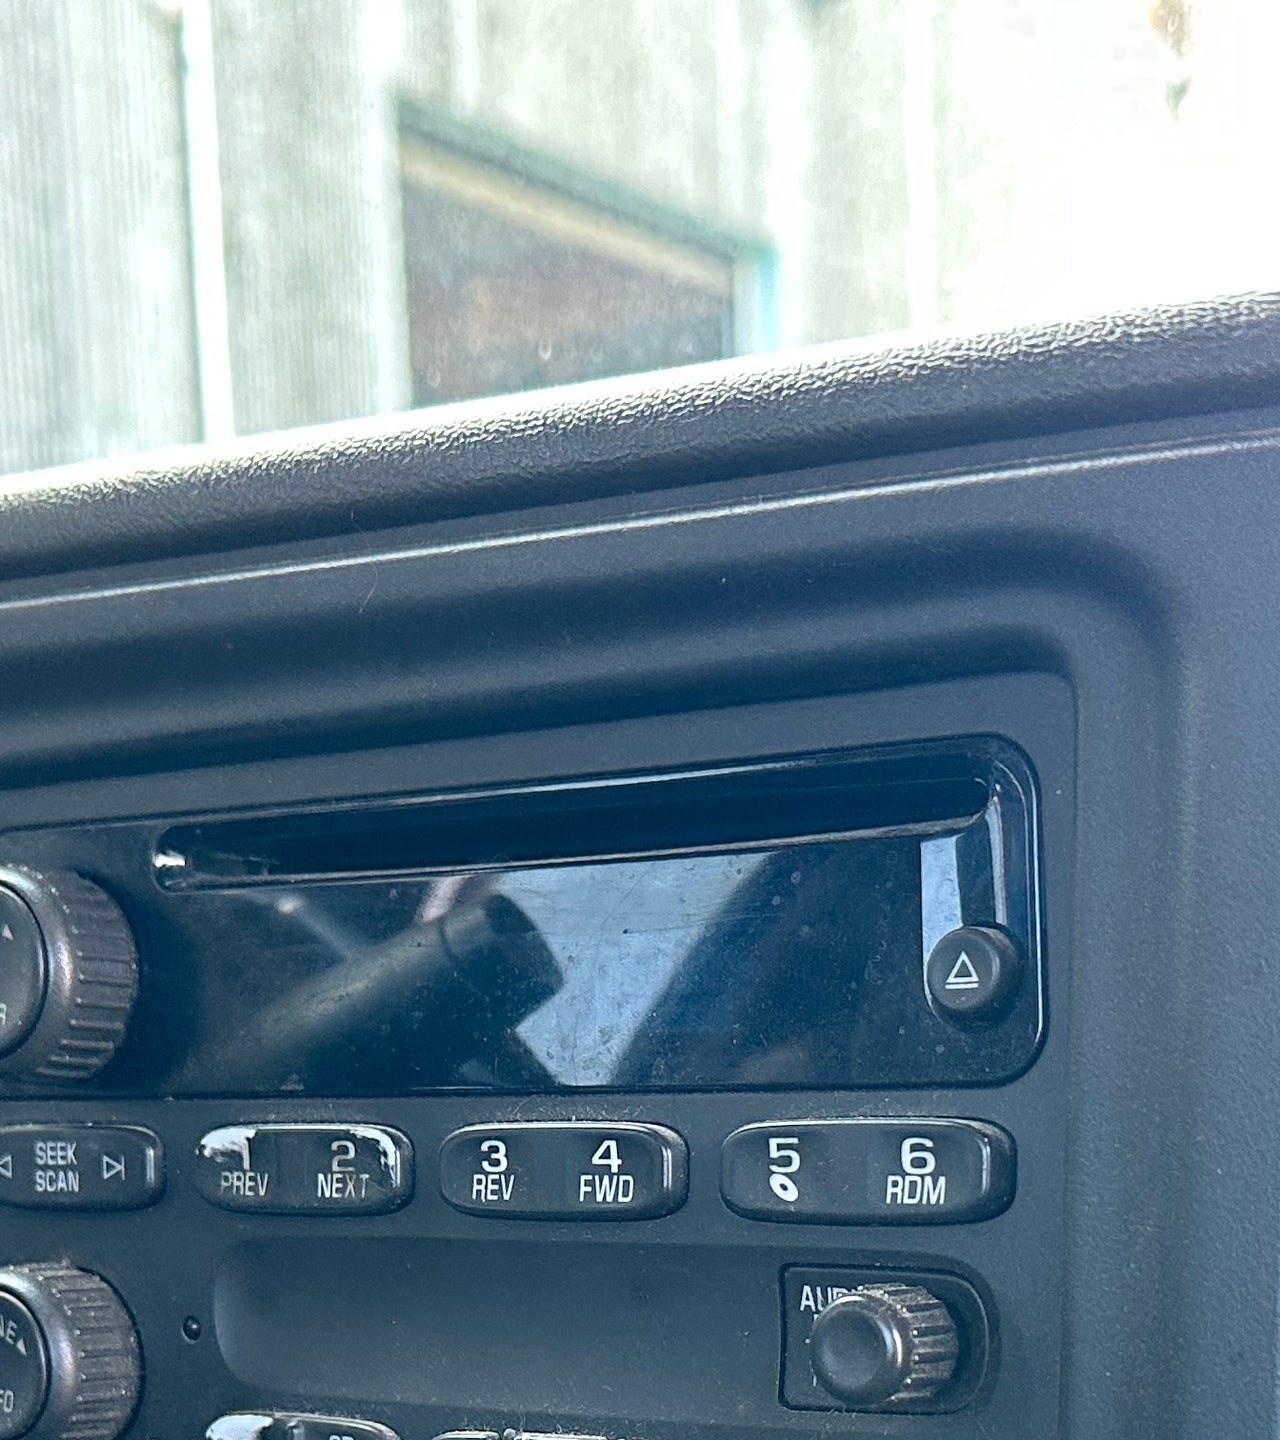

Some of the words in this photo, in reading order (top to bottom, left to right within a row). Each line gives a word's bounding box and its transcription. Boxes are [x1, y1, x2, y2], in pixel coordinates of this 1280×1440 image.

[34, 1141, 78, 1167] SEEK
[330, 1139, 357, 1172] 2
[480, 1139, 509, 1173] 3
[591, 1139, 622, 1173] 4
[768, 1137, 801, 1173] 5
[900, 1137, 936, 1175] 6
[34, 1170, 80, 1194] SCAN
[220, 1171, 269, 1197] PREV
[317, 1172, 370, 1199] NEXT
[471, 1174, 515, 1203] REV
[578, 1174, 634, 1203] FWD
[885, 1175, 946, 1206] RDM
